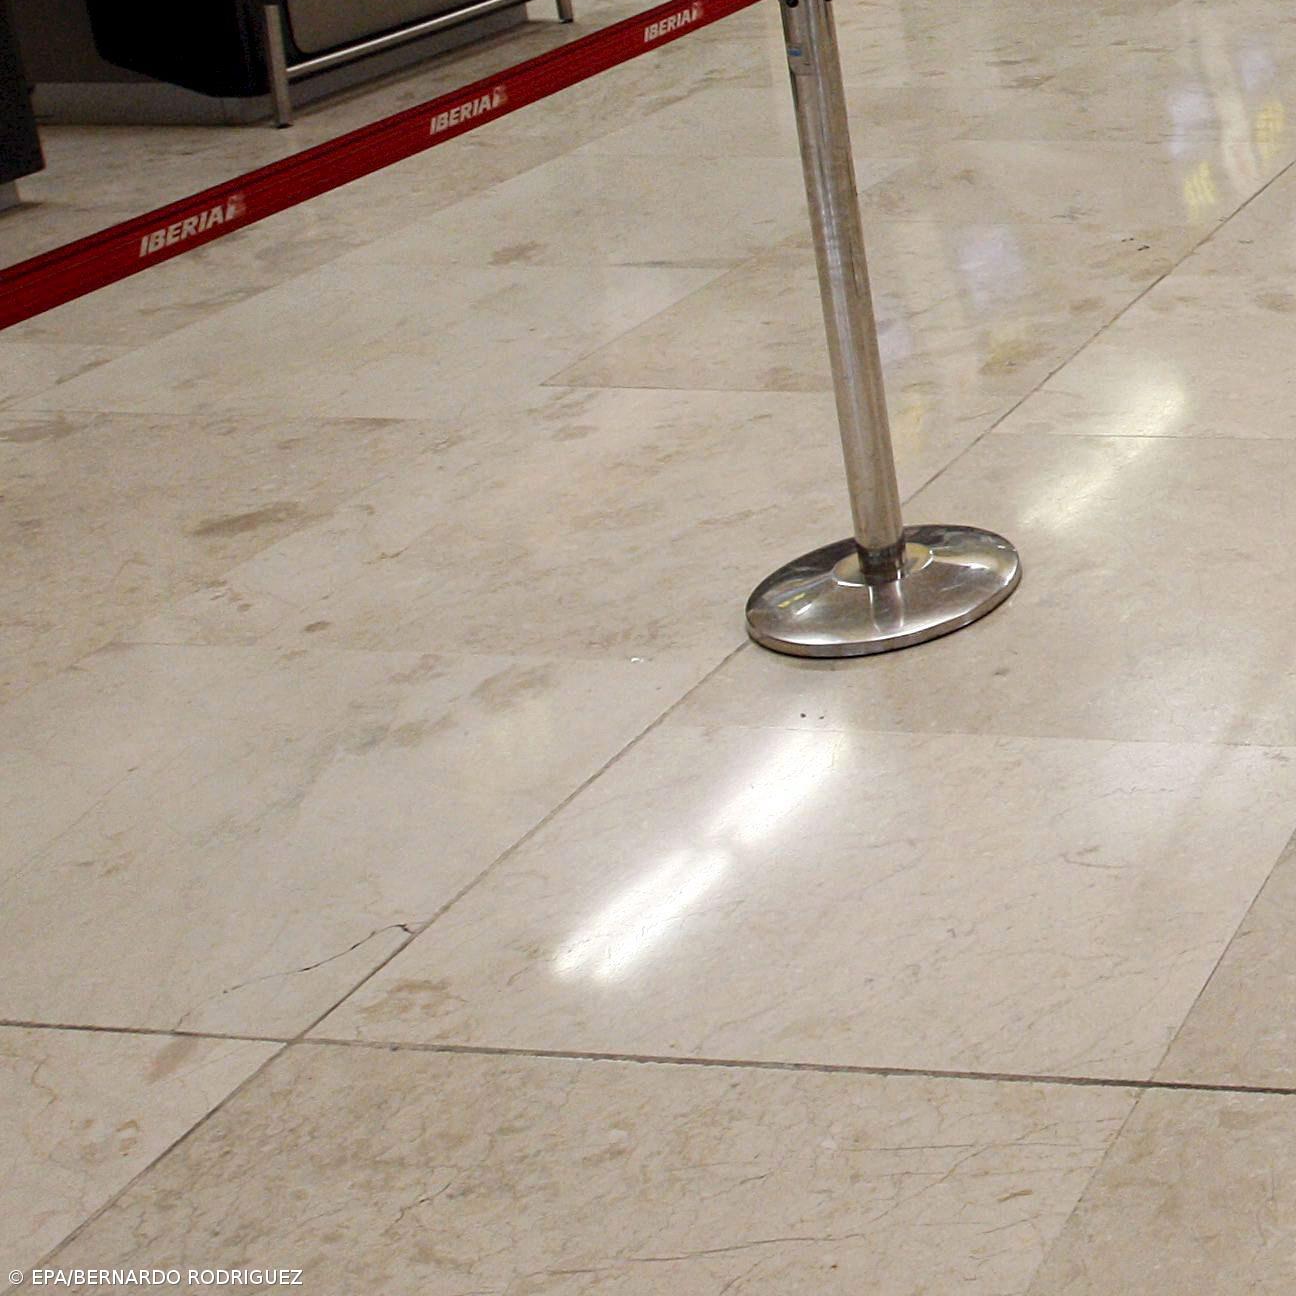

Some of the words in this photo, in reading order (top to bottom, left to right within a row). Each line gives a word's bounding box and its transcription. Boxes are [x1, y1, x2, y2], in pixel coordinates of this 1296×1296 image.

[643, 10, 693, 43] IBERIA
[430, 94, 492, 135] IBERIA
[139, 205, 225, 257] IBERIA
